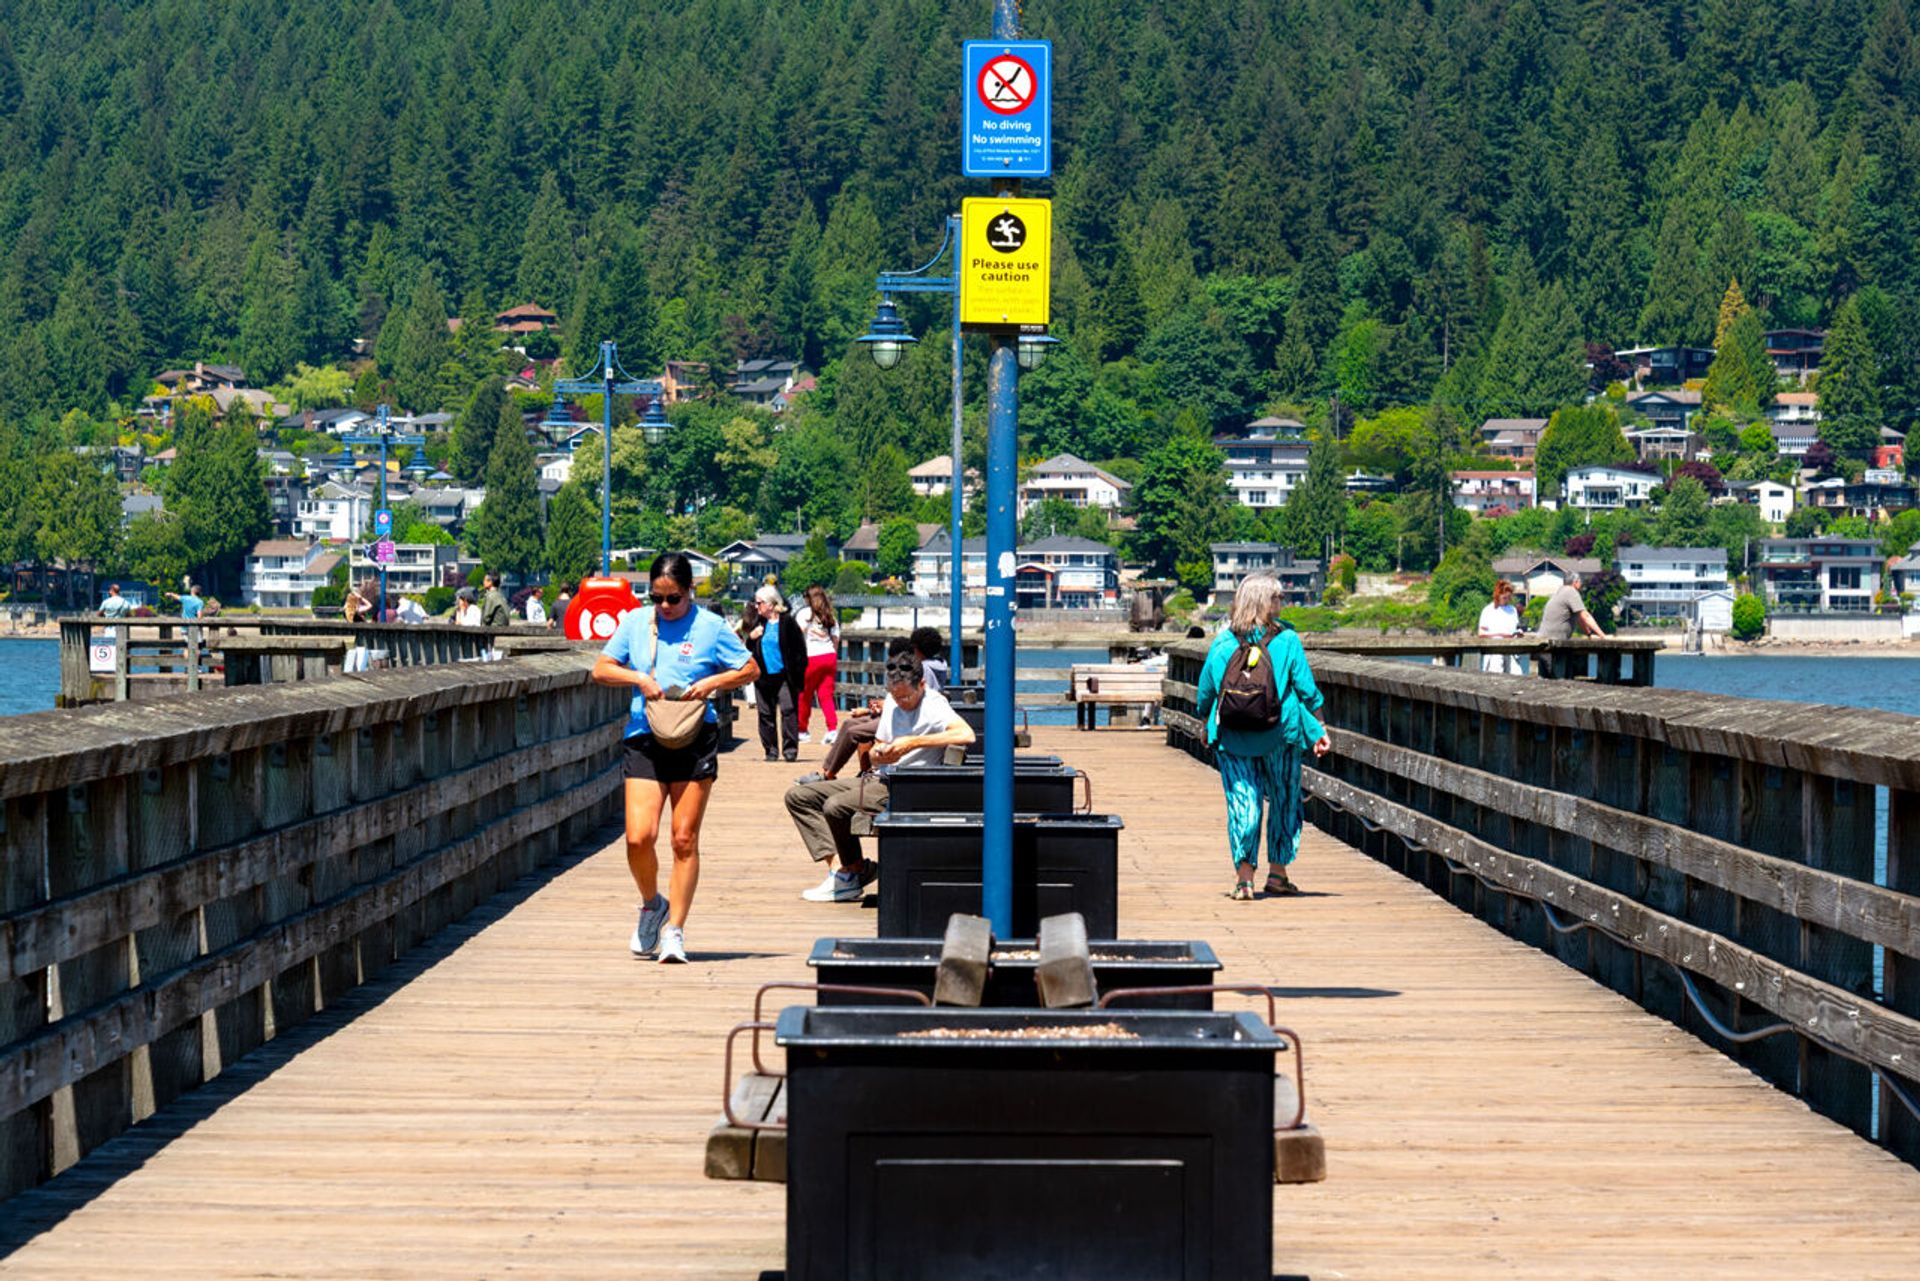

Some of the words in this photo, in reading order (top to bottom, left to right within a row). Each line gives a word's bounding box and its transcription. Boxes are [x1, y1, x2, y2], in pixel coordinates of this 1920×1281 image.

[982, 119, 997, 130] No
[999, 119, 1032, 132] diving
[972, 134, 987, 144] No
[989, 134, 1041, 147] swimming
[972, 258, 1014, 270] Please
[1017, 262, 1039, 270] use
[981, 271, 1030, 282] caution
[99, 648, 107, 658] 5
